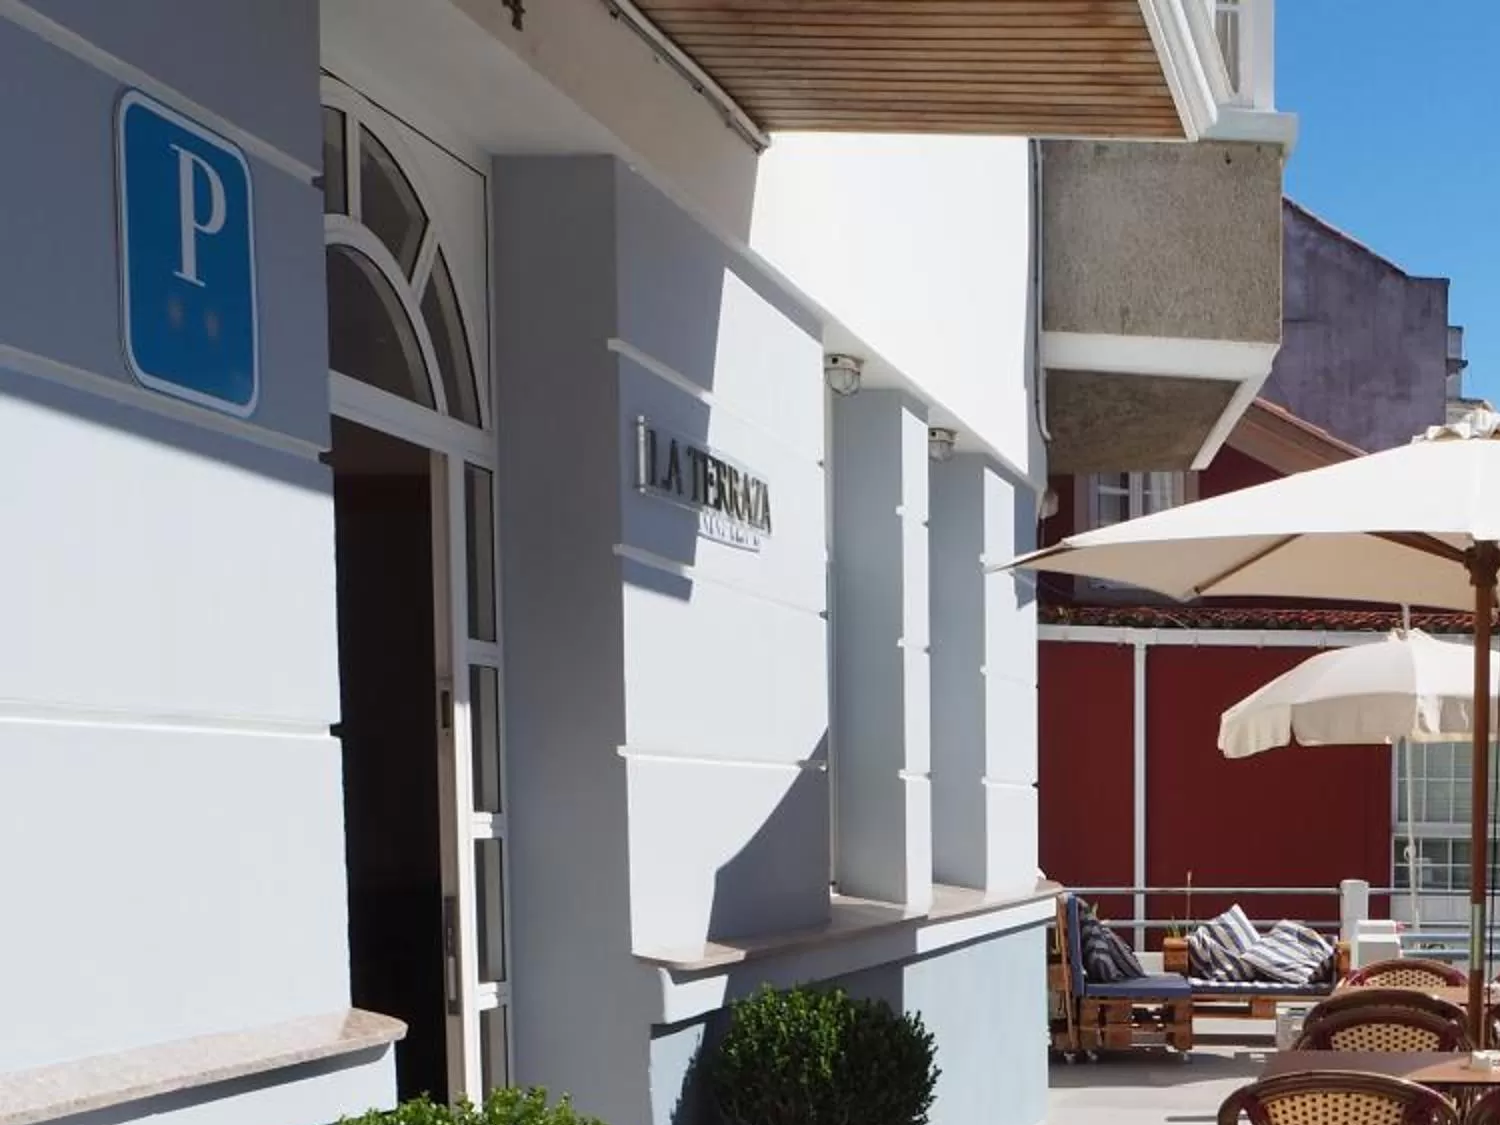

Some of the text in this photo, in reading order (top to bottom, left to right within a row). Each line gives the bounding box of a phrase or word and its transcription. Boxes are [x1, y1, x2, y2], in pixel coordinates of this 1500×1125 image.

[168, 143, 227, 287] P
[648, 429, 683, 495] LA
[686, 446, 772, 535] TERRAZA
